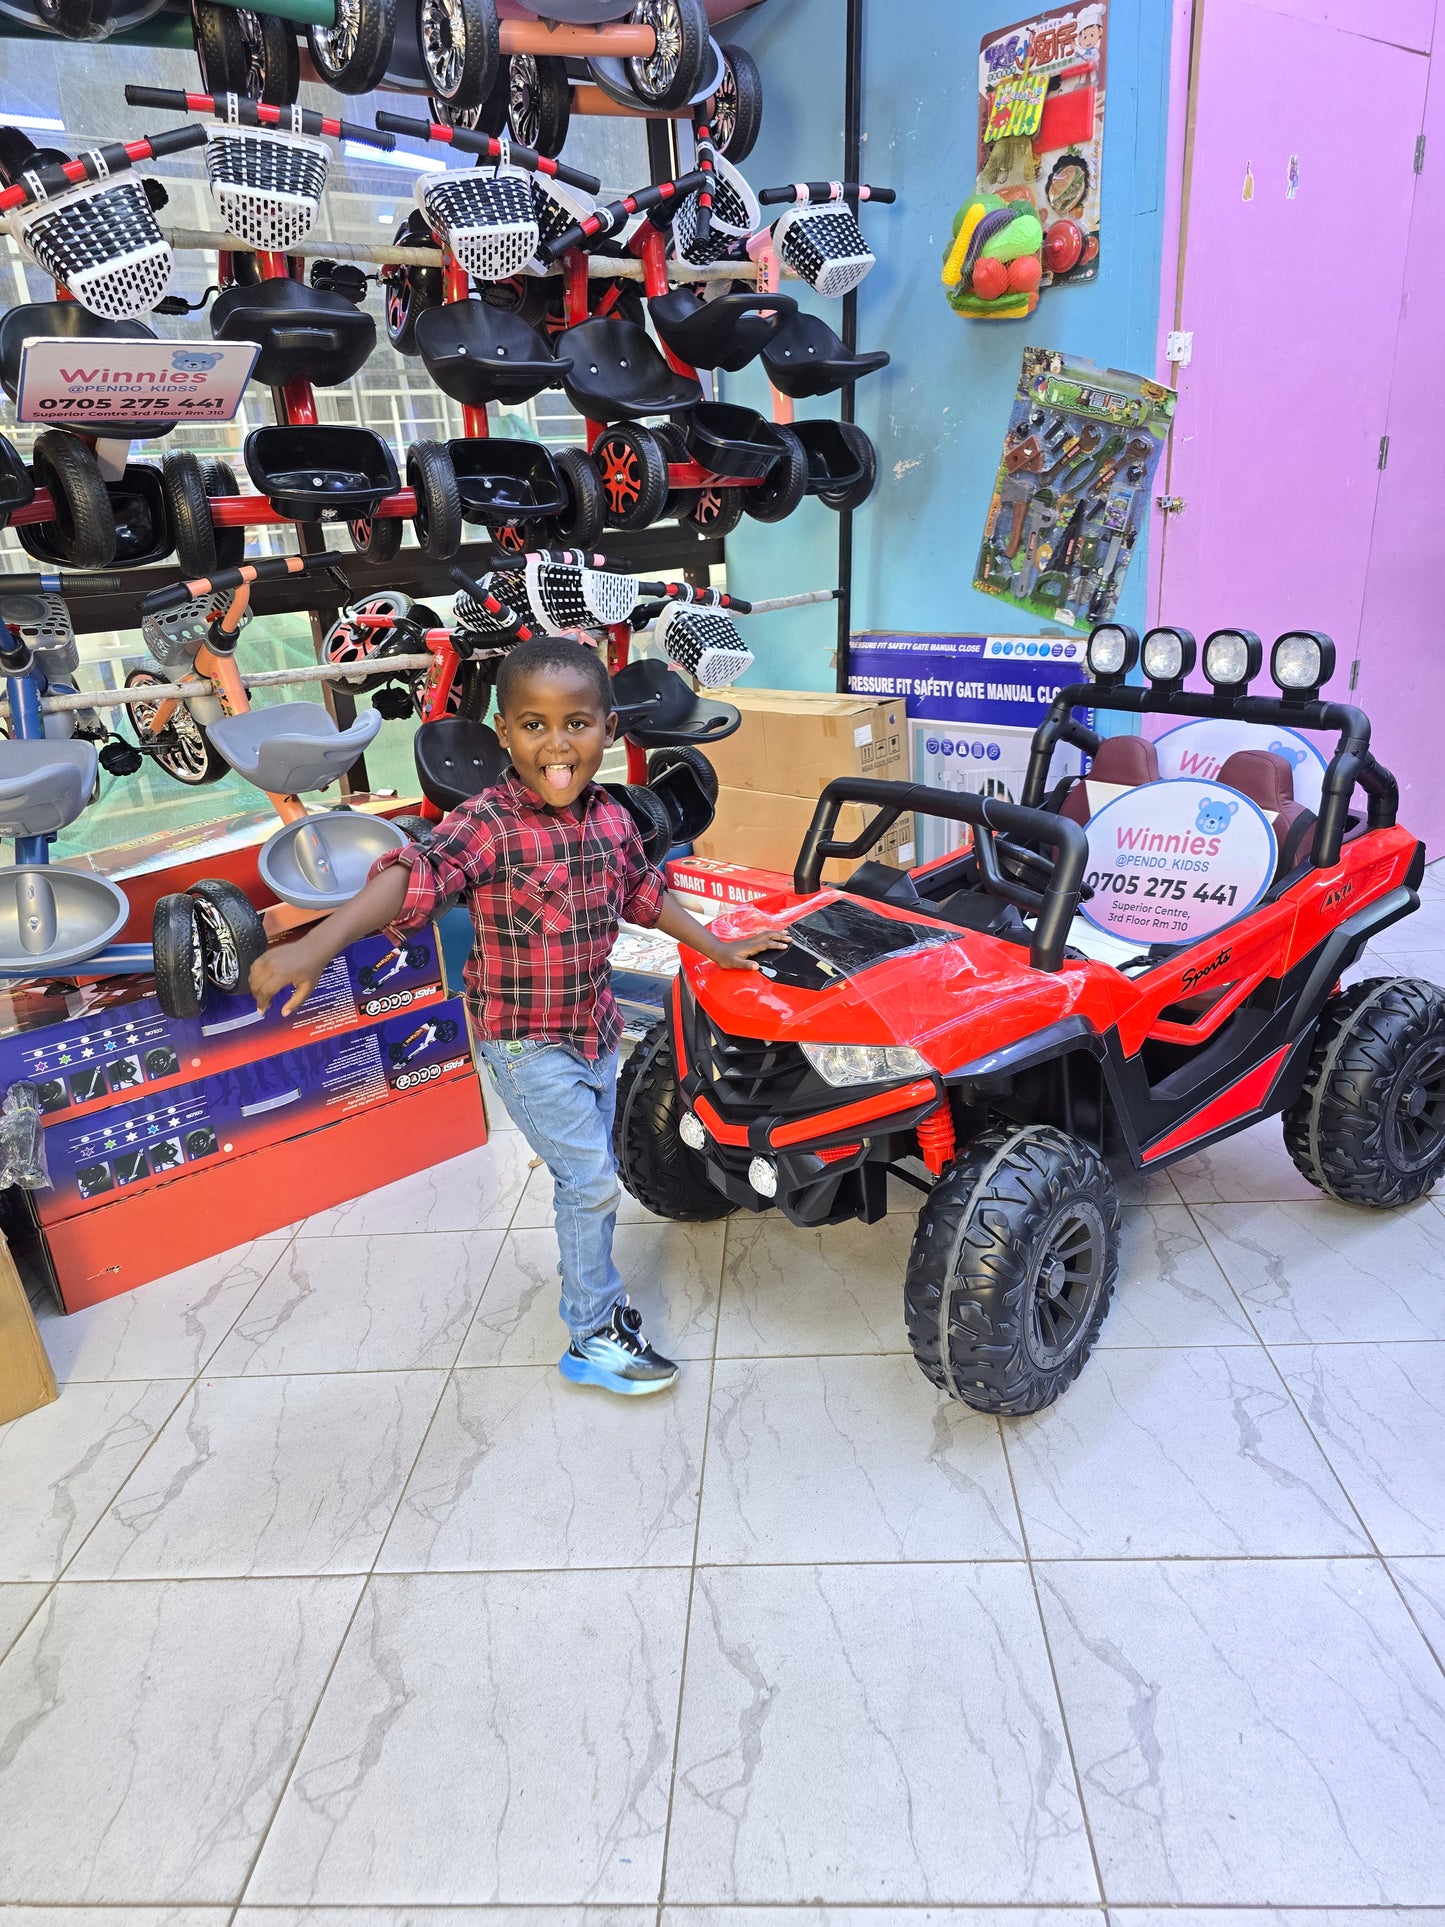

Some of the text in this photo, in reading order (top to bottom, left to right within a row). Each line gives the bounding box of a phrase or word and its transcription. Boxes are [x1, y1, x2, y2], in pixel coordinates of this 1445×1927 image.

[59, 368, 208, 384] Winnies
[68, 385, 198, 394] @PENDO_KIDSS
[39, 398, 224, 410] 0705 275 441
[877, 641, 888, 649] FIT
[887, 642, 913, 650] SAFETY
[912, 642, 930, 651] GATE
[929, 643, 957, 652] MANUAL
[958, 644, 981, 653] CLOSE
[896, 678, 912, 695] FIT
[914, 678, 953, 698] SAFETY
[956, 681, 985, 700] GATE
[987, 684, 1035, 703] MANUAL
[1116, 827, 1221, 857] Winnies
[1115, 854, 1210, 873] @PENDO_KIDSS
[673, 872, 705, 893] SMART
[711, 881, 723, 897] 10
[1086, 872, 1238, 906] 0705 275 441
[1112, 900, 1191, 919] Superior Centre,
[1108, 913, 1188, 931] 3rd Floor Rm J10
[1181, 947, 1232, 992] Sports
[413, 986, 437, 1000] FAST
[442, 1058, 465, 1073] FAST
[119, 1177, 126, 1185] 3
[83, 1190, 89, 1198] 4
